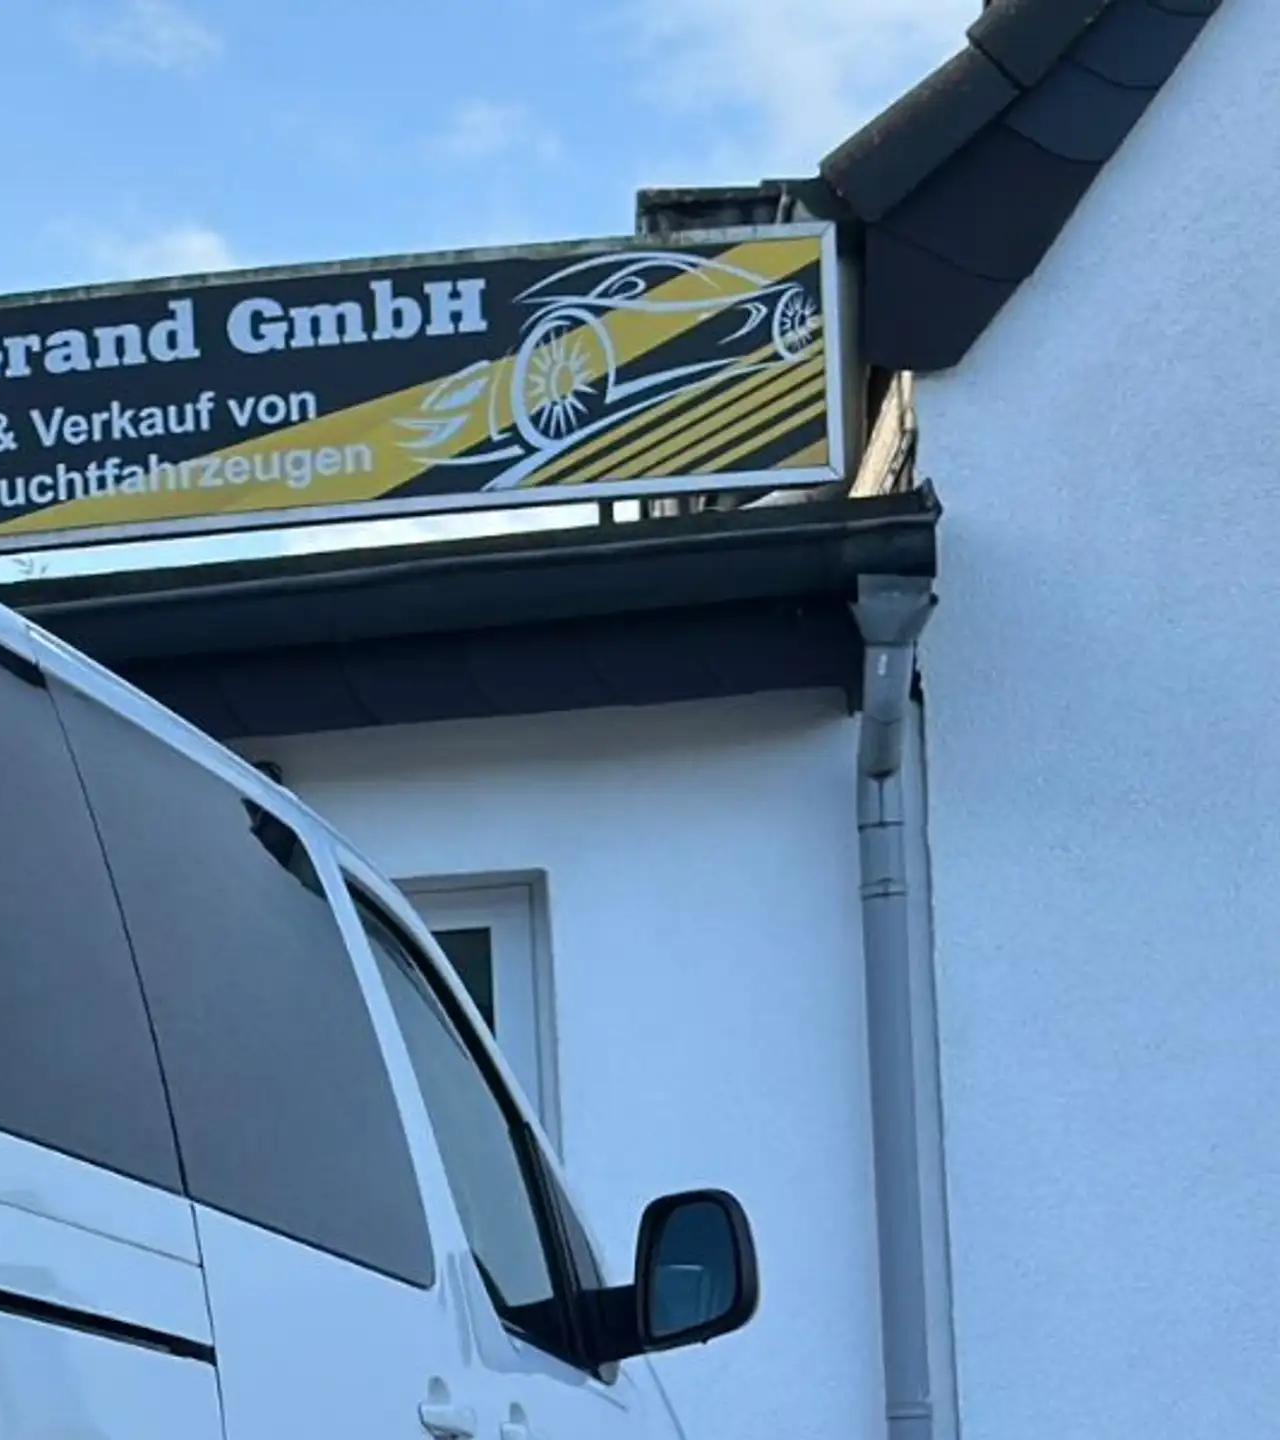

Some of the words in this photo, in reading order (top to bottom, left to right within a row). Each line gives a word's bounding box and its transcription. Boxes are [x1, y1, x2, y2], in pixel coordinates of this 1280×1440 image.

[226, 277, 488, 354] GmbH
[28, 390, 216, 448] Verkauf
[227, 390, 318, 428] von
